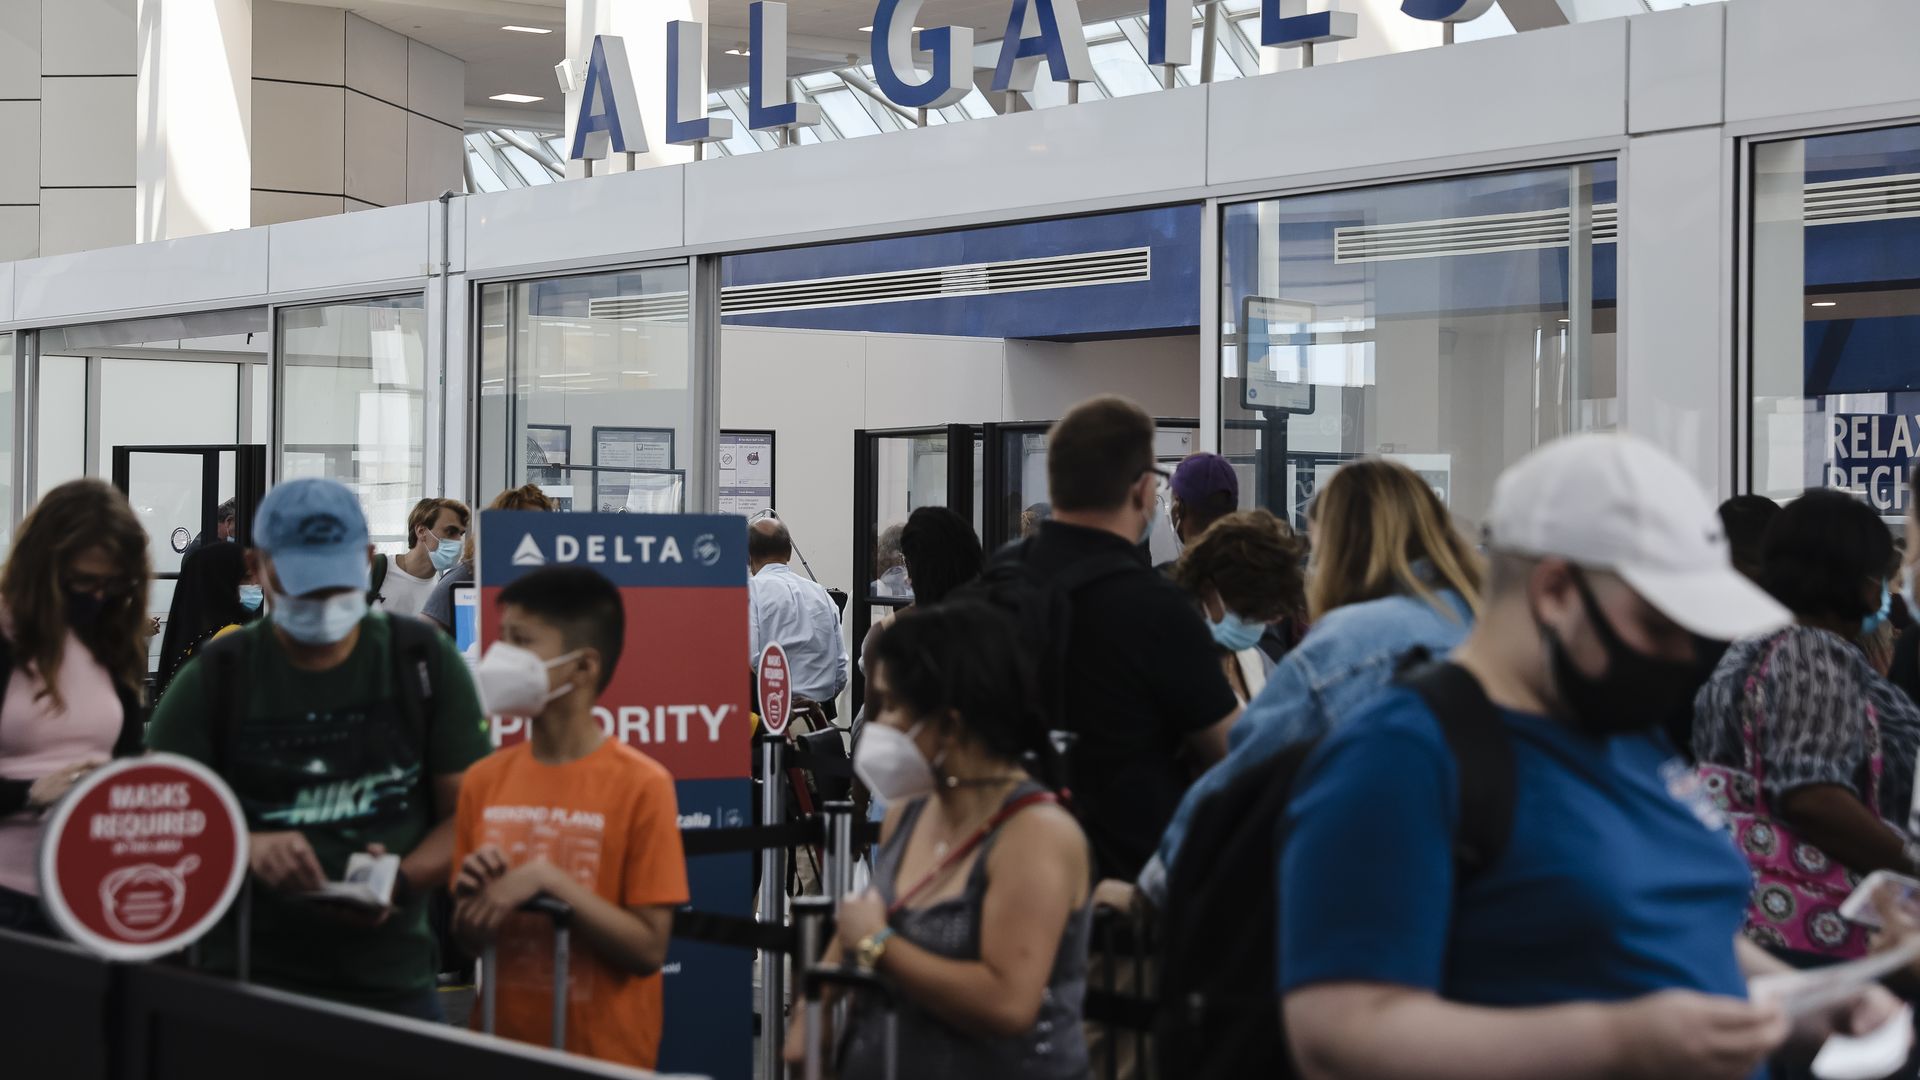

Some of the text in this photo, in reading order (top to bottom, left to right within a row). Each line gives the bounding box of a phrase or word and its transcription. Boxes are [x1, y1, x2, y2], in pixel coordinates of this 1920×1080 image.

[571, 1, 820, 159] ALL
[1828, 414, 1920, 459] RELA
[556, 534, 683, 563] DELTA
[490, 704, 730, 747] PORITY
[109, 782, 190, 809] MASKS
[90, 810, 206, 839] REQUIRED
